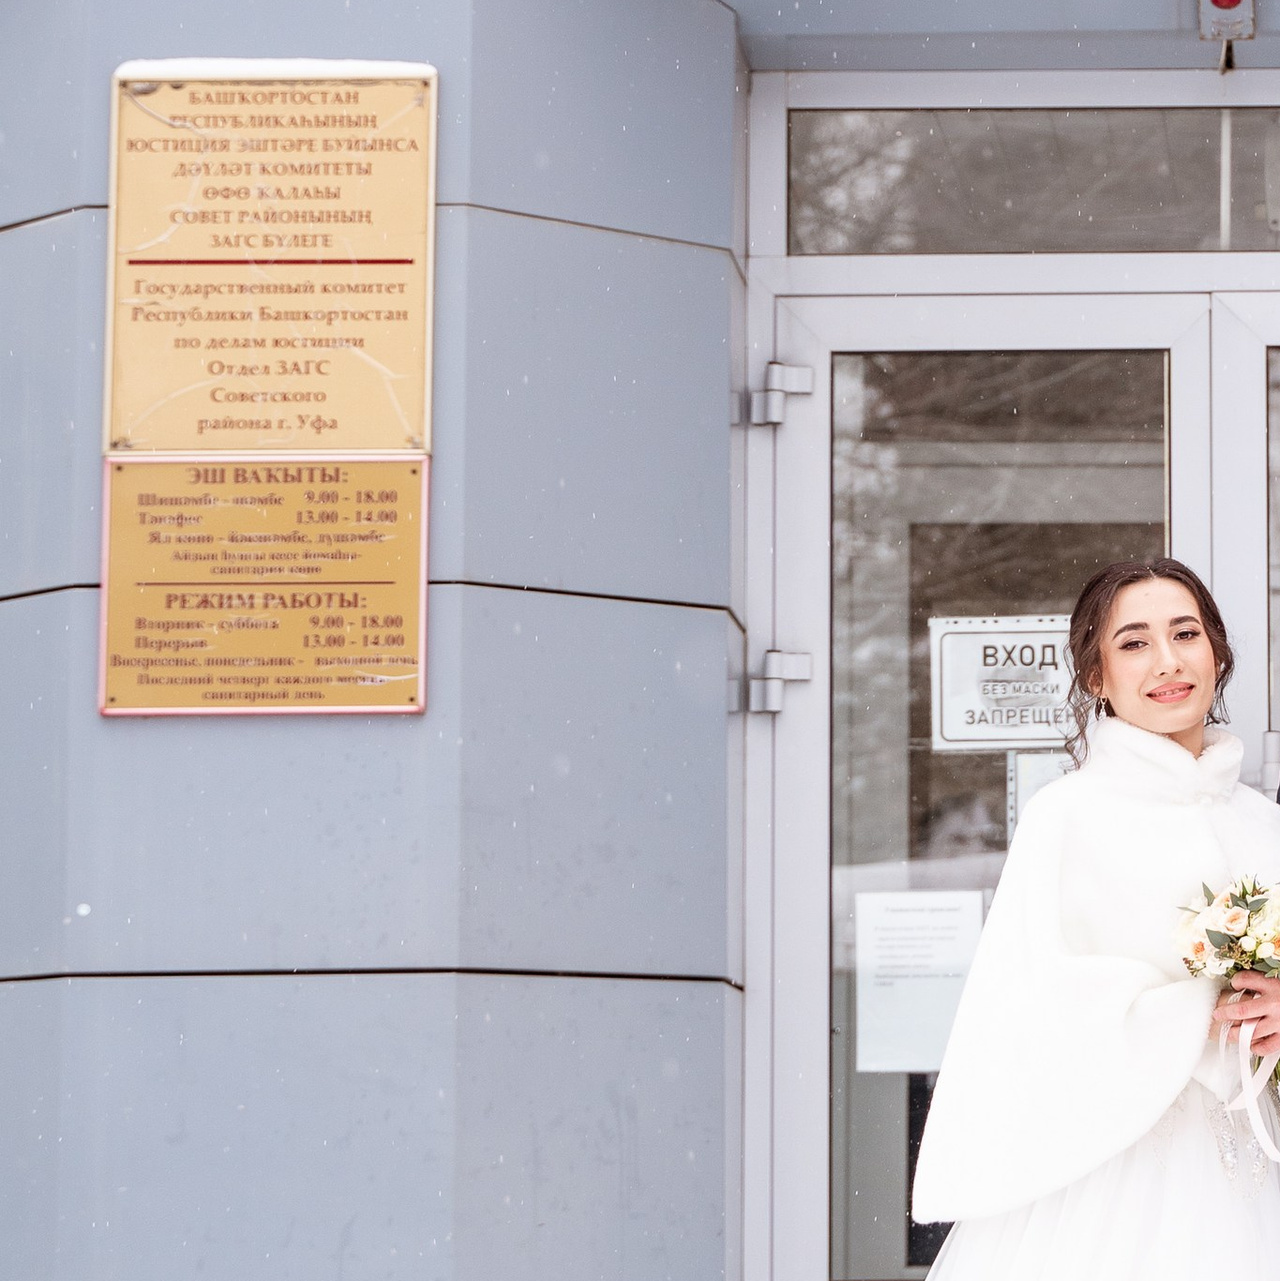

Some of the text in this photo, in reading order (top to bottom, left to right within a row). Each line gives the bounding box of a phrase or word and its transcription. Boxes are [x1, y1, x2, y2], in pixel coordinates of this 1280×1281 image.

[126, 138, 230, 154] ЮСТИЦИЯ
[259, 162, 373, 177] КОМИТЕТЫ
[169, 210, 232, 224] СОВЕТ
[209, 234, 259, 248] ЗАГС
[133, 280, 406, 298] Государственный комитет
[130, 306, 409, 326] Республики Башкортостан
[174, 337, 365, 350] по делам юстиции
[206, 360, 331, 377] Отдел ЗАГС
[209, 387, 327, 404] Советского
[197, 415, 339, 435] района г. Уфа
[187, 467, 226, 484] ЭШ
[303, 490, 339, 504] 9.00
[355, 490, 399, 504] 18.00
[296, 509, 339, 524] 13.00
[355, 509, 399, 524] 14.00
[165, 592, 367, 609] РЕЖИМ РАБОТЫ:
[135, 617, 205, 632] Вторник
[217, 617, 279, 633] суббота
[309, 615, 344, 628] 9.00
[361, 615, 404, 628] 18.00
[135, 636, 208, 651] Перерыв
[303, 634, 346, 648] 13.00
[363, 634, 405, 647] 14.00
[982, 644, 1059, 670] ВХОД
[137, 672, 214, 686] Последний
[294, 691, 326, 700] день
[982, 683, 1060, 696] БЕЗ МАСКИ
